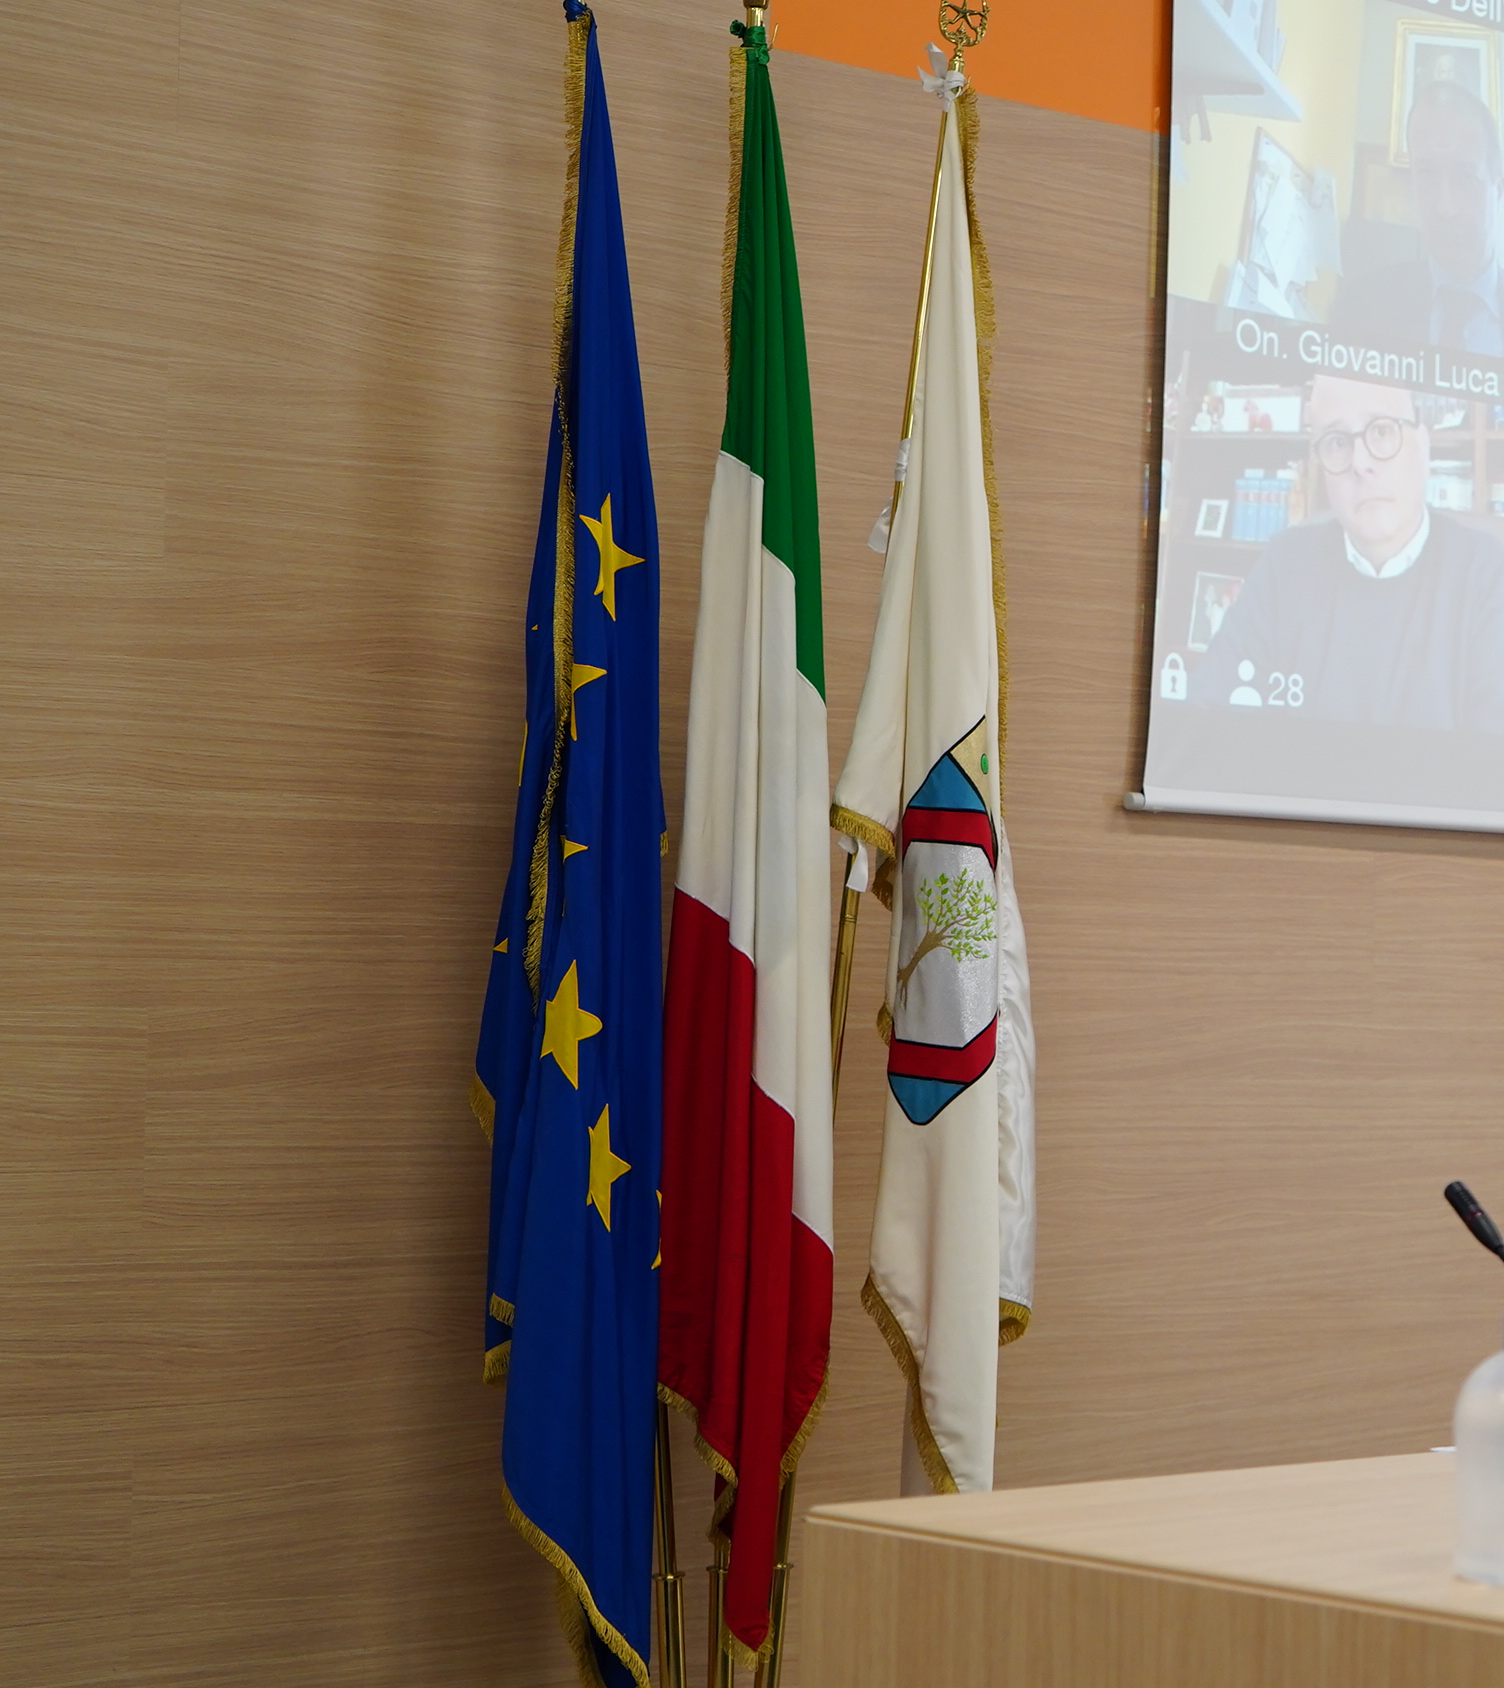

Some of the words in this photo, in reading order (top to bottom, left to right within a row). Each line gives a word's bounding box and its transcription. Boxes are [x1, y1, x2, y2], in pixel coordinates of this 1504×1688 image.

[1235, 318, 1288, 361] On.
[1298, 329, 1425, 384] Giovanni
[1434, 353, 1501, 397] Luca
[1267, 672, 1305, 707] 28
